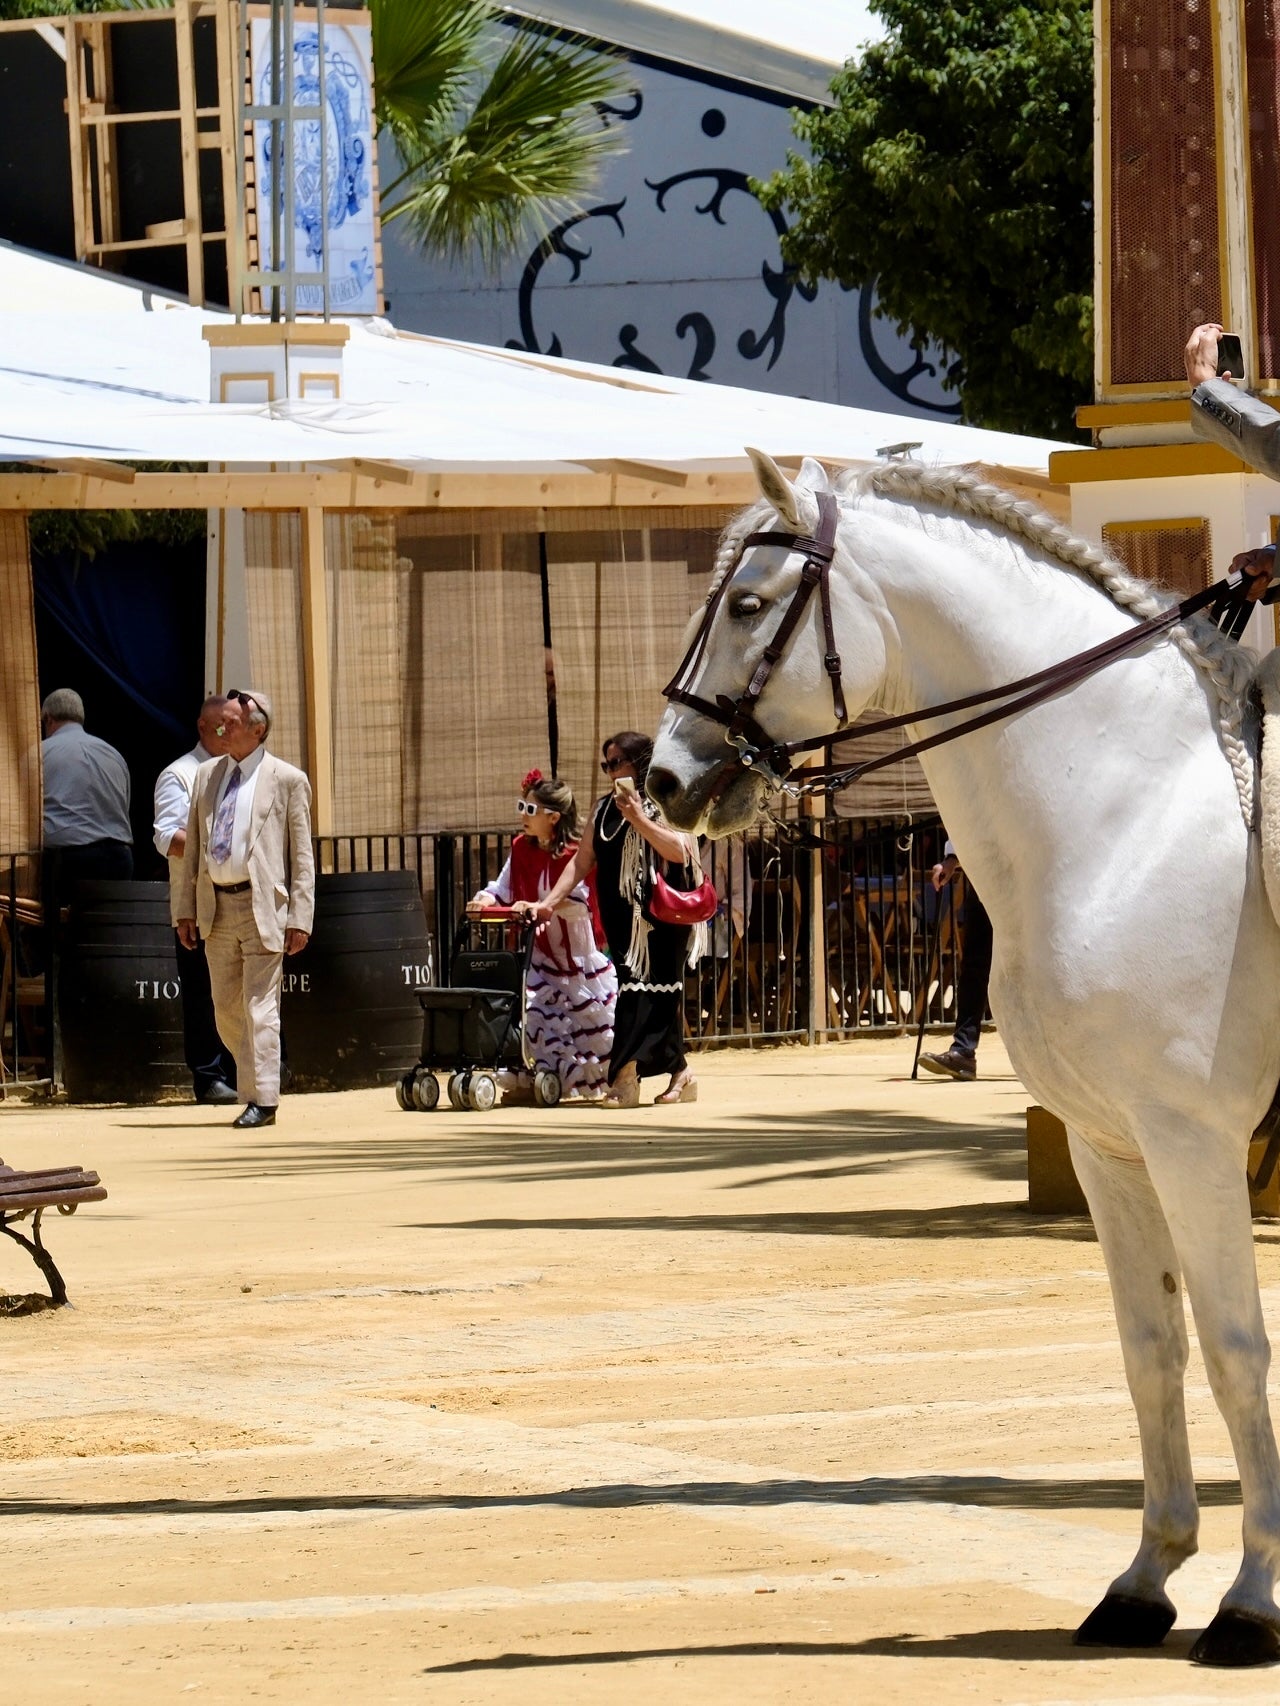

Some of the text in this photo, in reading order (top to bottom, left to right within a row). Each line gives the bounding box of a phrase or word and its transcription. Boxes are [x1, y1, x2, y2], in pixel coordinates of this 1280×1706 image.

[281, 973, 311, 993] EPE
[401, 965, 431, 985] TIO
[135, 980, 180, 999] TIO
